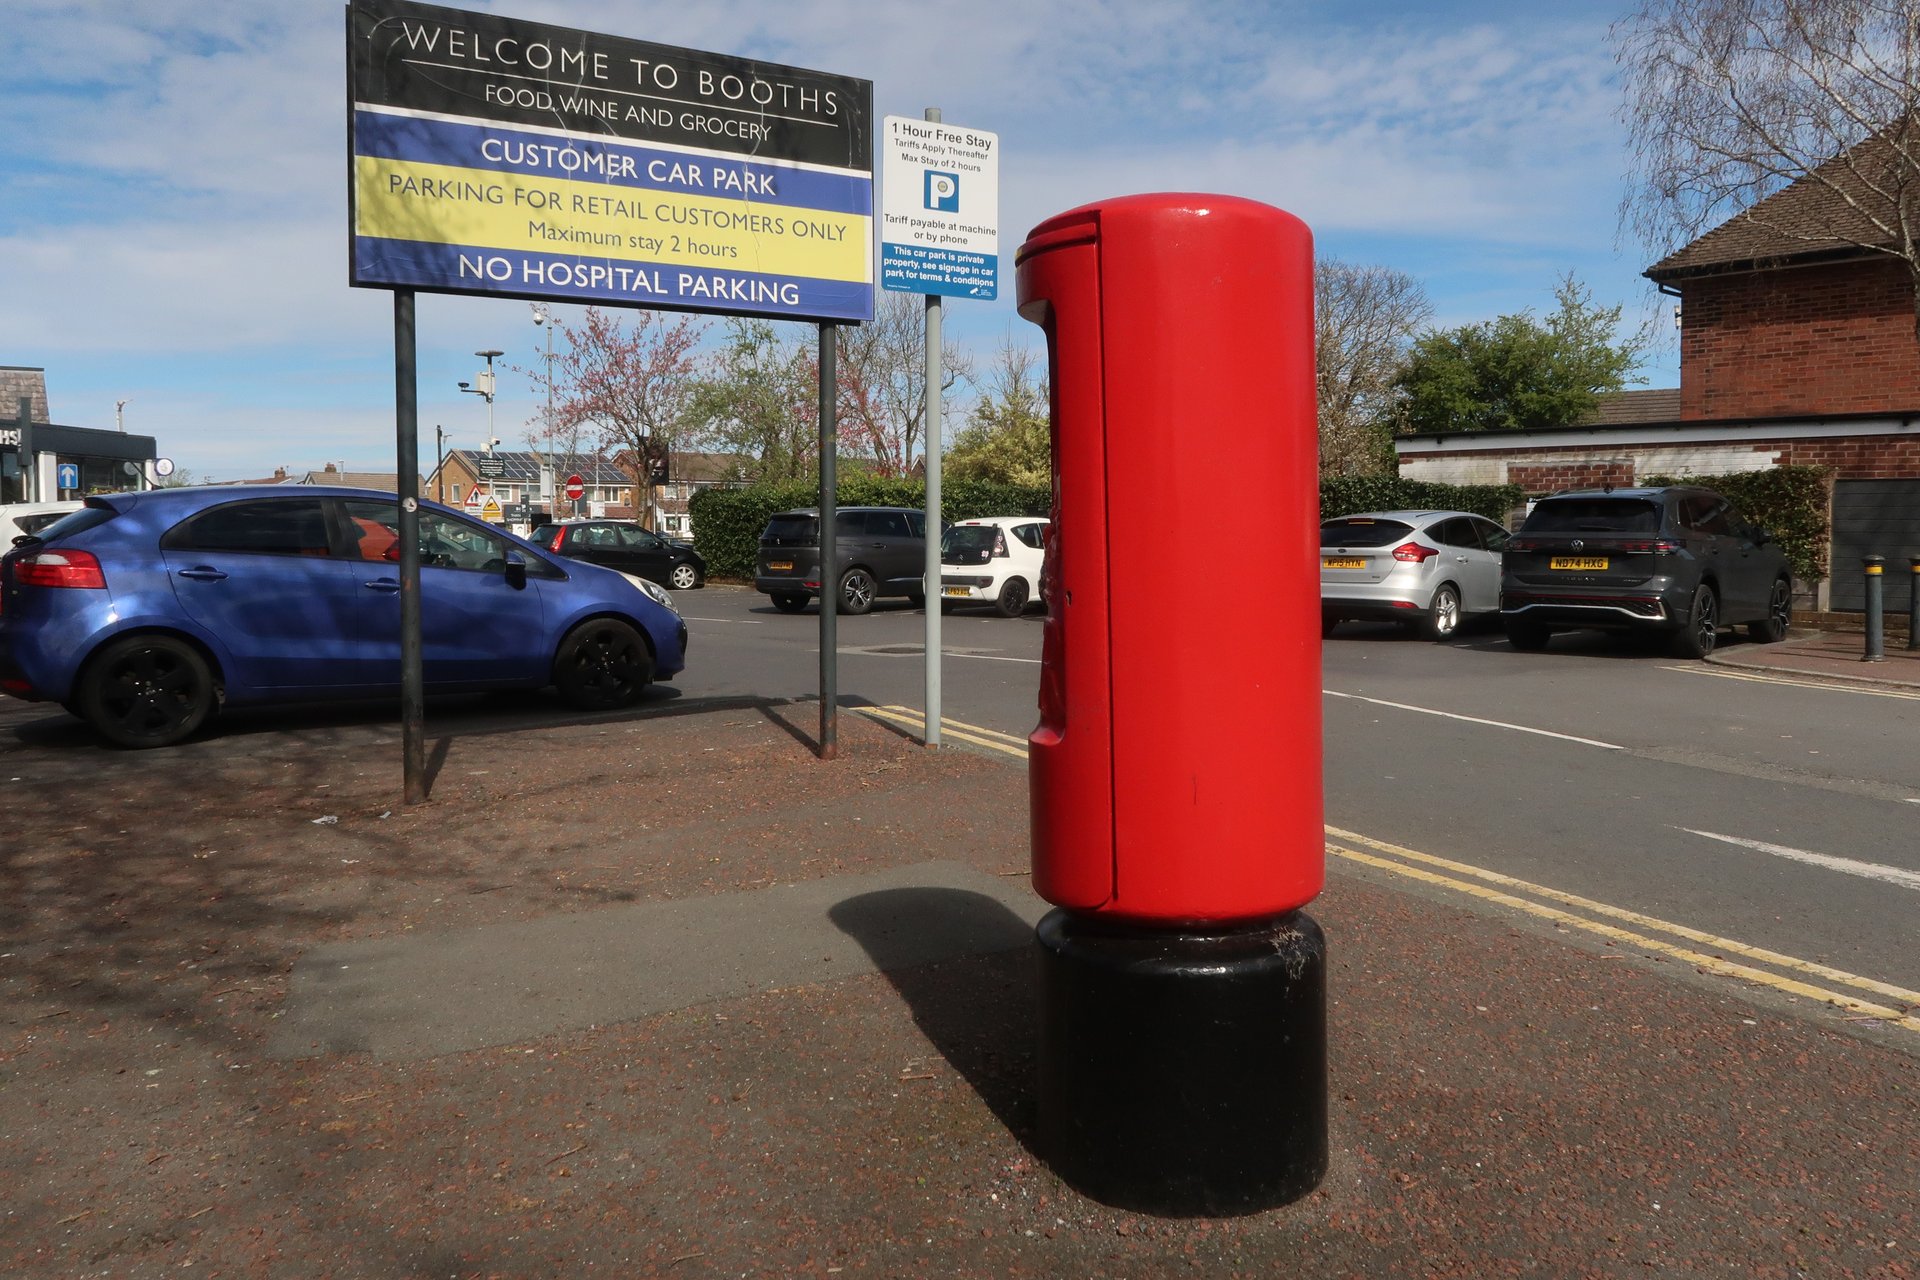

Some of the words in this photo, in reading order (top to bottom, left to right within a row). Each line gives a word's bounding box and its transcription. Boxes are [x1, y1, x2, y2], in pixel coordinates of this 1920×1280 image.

[402, 21, 608, 80] WELCOME
[630, 58, 677, 89] TO
[699, 70, 837, 116] BOOTHS
[559, 95, 618, 120] WINE
[625, 105, 673, 127] AND
[679, 113, 772, 141] GROCERY
[892, 122, 898, 133] 1
[903, 123, 932, 139] Hour
[936, 129, 962, 143] Free
[966, 134, 992, 151] Stay
[894, 138, 920, 149] Tariffs
[921, 143, 945, 155] Apply
[948, 146, 988, 160] Thereafter
[481, 138, 638, 179] CUSTOMER
[648, 160, 704, 187] CAR
[713, 168, 776, 196] PARK
[901, 152, 918, 163] Max
[921, 156, 938, 168] Stay
[958, 162, 981, 173] hours
[930, 174, 955, 208] P
[389, 174, 504, 204] PARKING
[515, 188, 562, 211] FOR
[573, 194, 648, 220] RETAIL
[655, 204, 784, 234] CUSTOMERS
[792, 220, 847, 241] ONLY
[884, 213, 908, 224] Tariff
[910, 217, 946, 229] payable
[948, 223, 957, 231] at
[959, 225, 997, 236] machine
[528, 220, 622, 247] Maximum
[629, 234, 664, 255] stay
[670, 235, 681, 253] 2
[688, 237, 738, 258] hours
[914, 231, 924, 239] or
[926, 232, 937, 242] by
[940, 234, 968, 245] phone
[883, 258, 920, 270] property,
[922, 262, 937, 270] see
[938, 263, 970, 275] signage
[971, 266, 979, 274] in
[981, 268, 994, 276] car
[893, 246, 912, 256] This
[928, 250, 946, 260] park
[948, 252, 956, 261] is
[957, 254, 985, 264] private
[459, 254, 513, 281] NO
[523, 259, 668, 294] HOSPITAL
[678, 273, 799, 305] PARKING
[885, 269, 904, 278] park
[906, 270, 919, 279] for
[919, 272, 943, 282] terms
[944, 274, 951, 282] &
[952, 275, 994, 287] conditions
[1555, 558, 1581, 568] ND74
